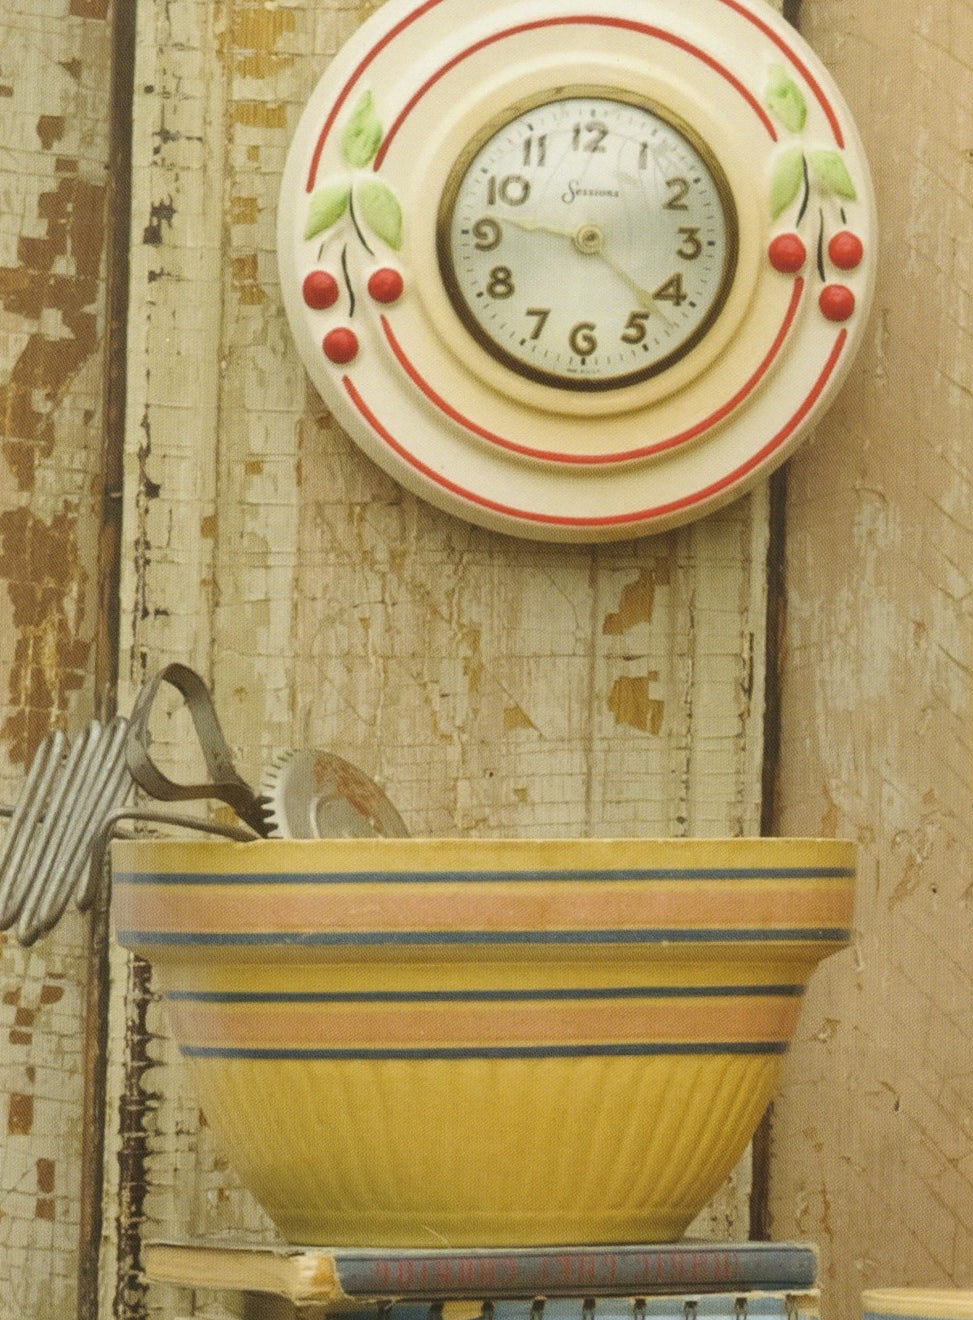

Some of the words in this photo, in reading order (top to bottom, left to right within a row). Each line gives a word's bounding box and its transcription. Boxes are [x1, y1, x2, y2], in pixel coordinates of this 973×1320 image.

[523, 133, 547, 167] 11
[572, 121, 609, 153] 12
[638, 141, 649, 170] 1
[487, 174, 531, 206] 10
[663, 177, 691, 211] 2
[472, 217, 502, 252] 9
[676, 226, 701, 260] 3
[486, 265, 515, 299] 8
[651, 272, 687, 306] 4
[525, 307, 551, 340] 7
[568, 321, 598, 357] 6
[620, 311, 650, 345] 5
